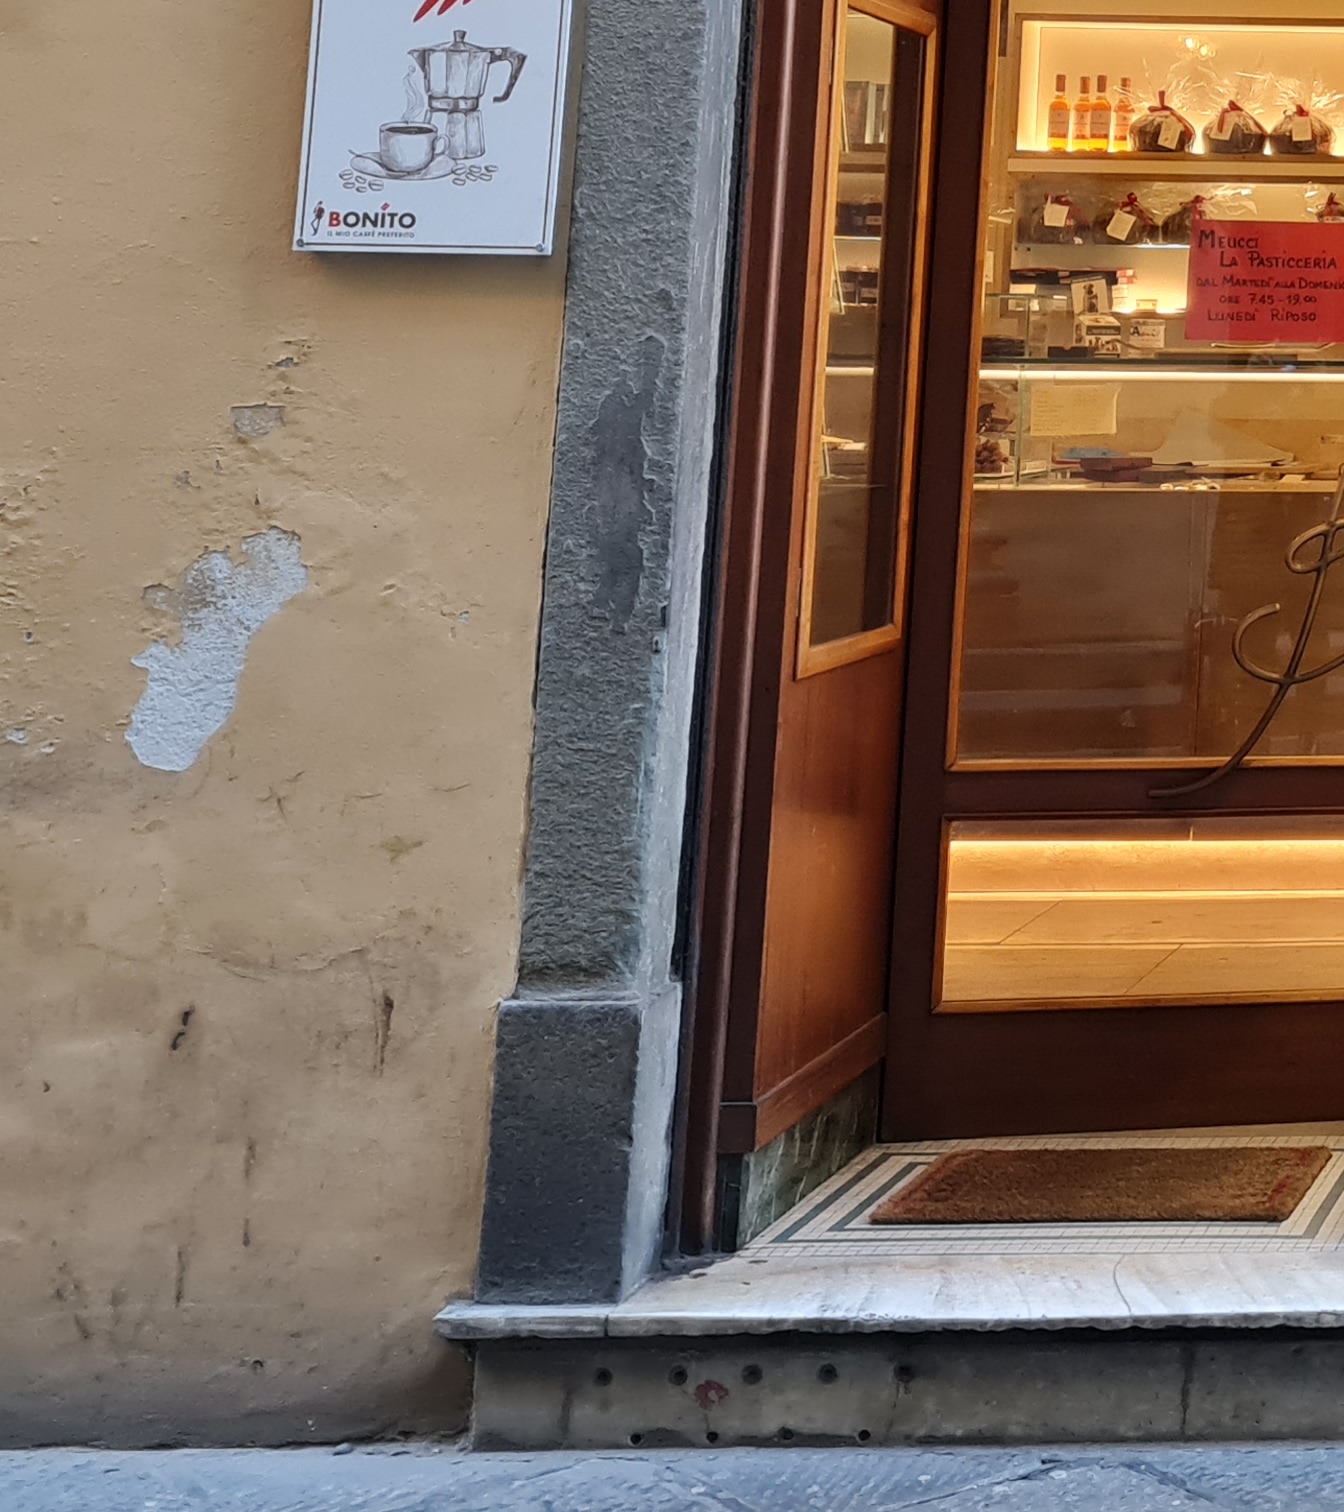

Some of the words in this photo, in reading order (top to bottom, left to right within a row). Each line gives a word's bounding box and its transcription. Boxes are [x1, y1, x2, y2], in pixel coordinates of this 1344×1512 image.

[328, 202, 416, 229] BONITO
[1220, 251, 1238, 267] LA
[1196, 277, 1217, 287] DAL
[1219, 294, 1240, 305] ORE
